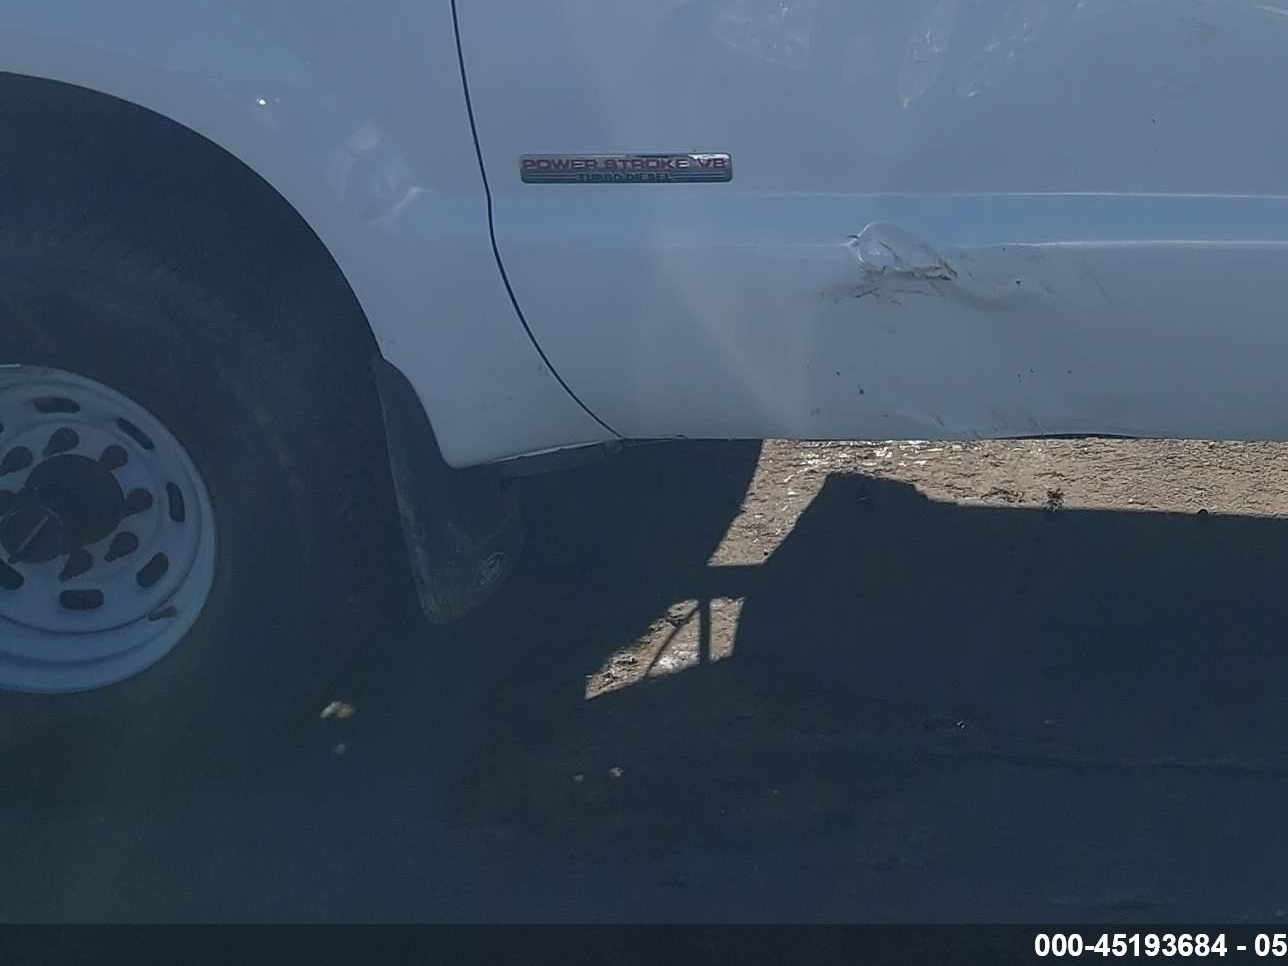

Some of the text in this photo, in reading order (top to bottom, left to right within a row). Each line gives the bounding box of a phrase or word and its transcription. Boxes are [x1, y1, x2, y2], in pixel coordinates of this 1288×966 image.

[522, 158, 727, 171] POWER STROKE V8
[578, 172, 673, 183] TURBO DIESEL
